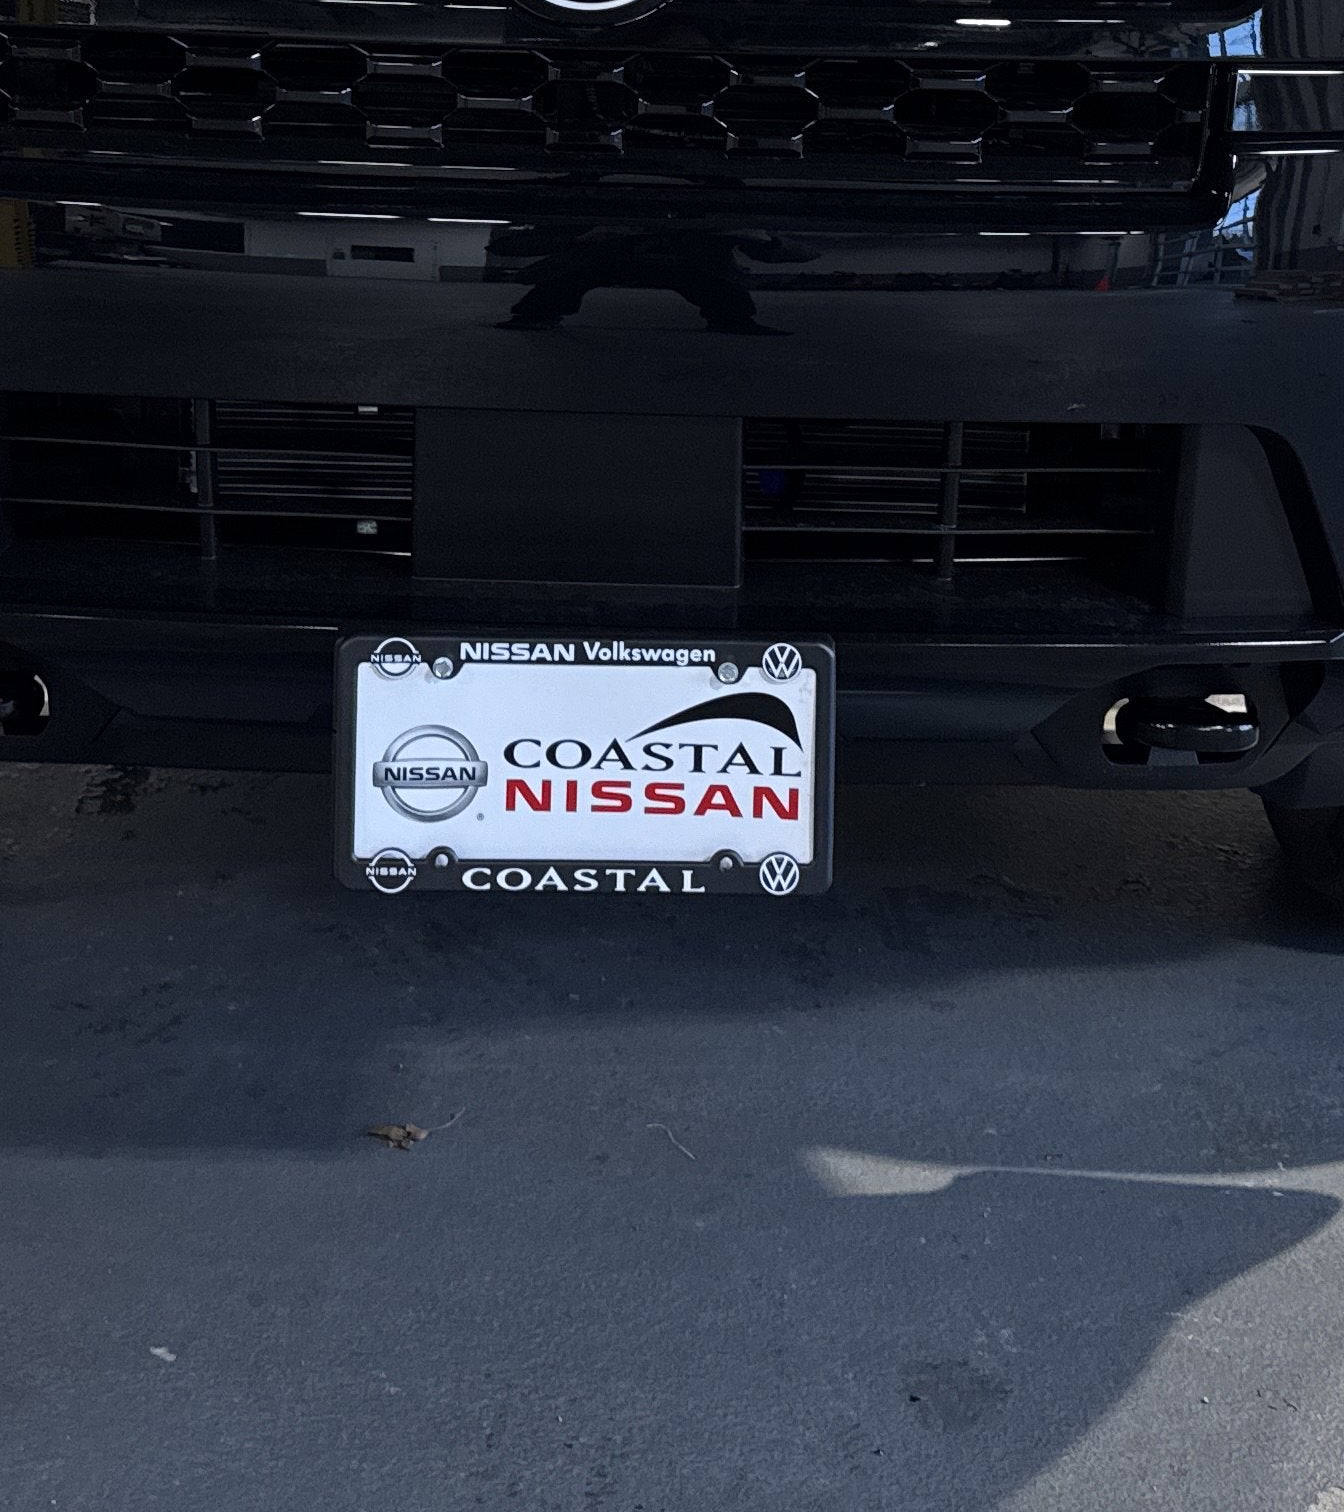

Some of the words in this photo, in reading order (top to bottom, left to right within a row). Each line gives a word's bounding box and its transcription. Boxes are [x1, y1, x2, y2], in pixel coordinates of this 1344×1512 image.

[370, 652, 422, 663] NISSAN
[460, 642, 575, 661] NISSAN
[583, 641, 716, 665] Volkswagen
[503, 738, 802, 778] COASTAL
[384, 767, 476, 781] NISSAN
[506, 779, 799, 820] NISSAN
[365, 866, 417, 877] NISSAN
[461, 866, 706, 893] COASTAL
